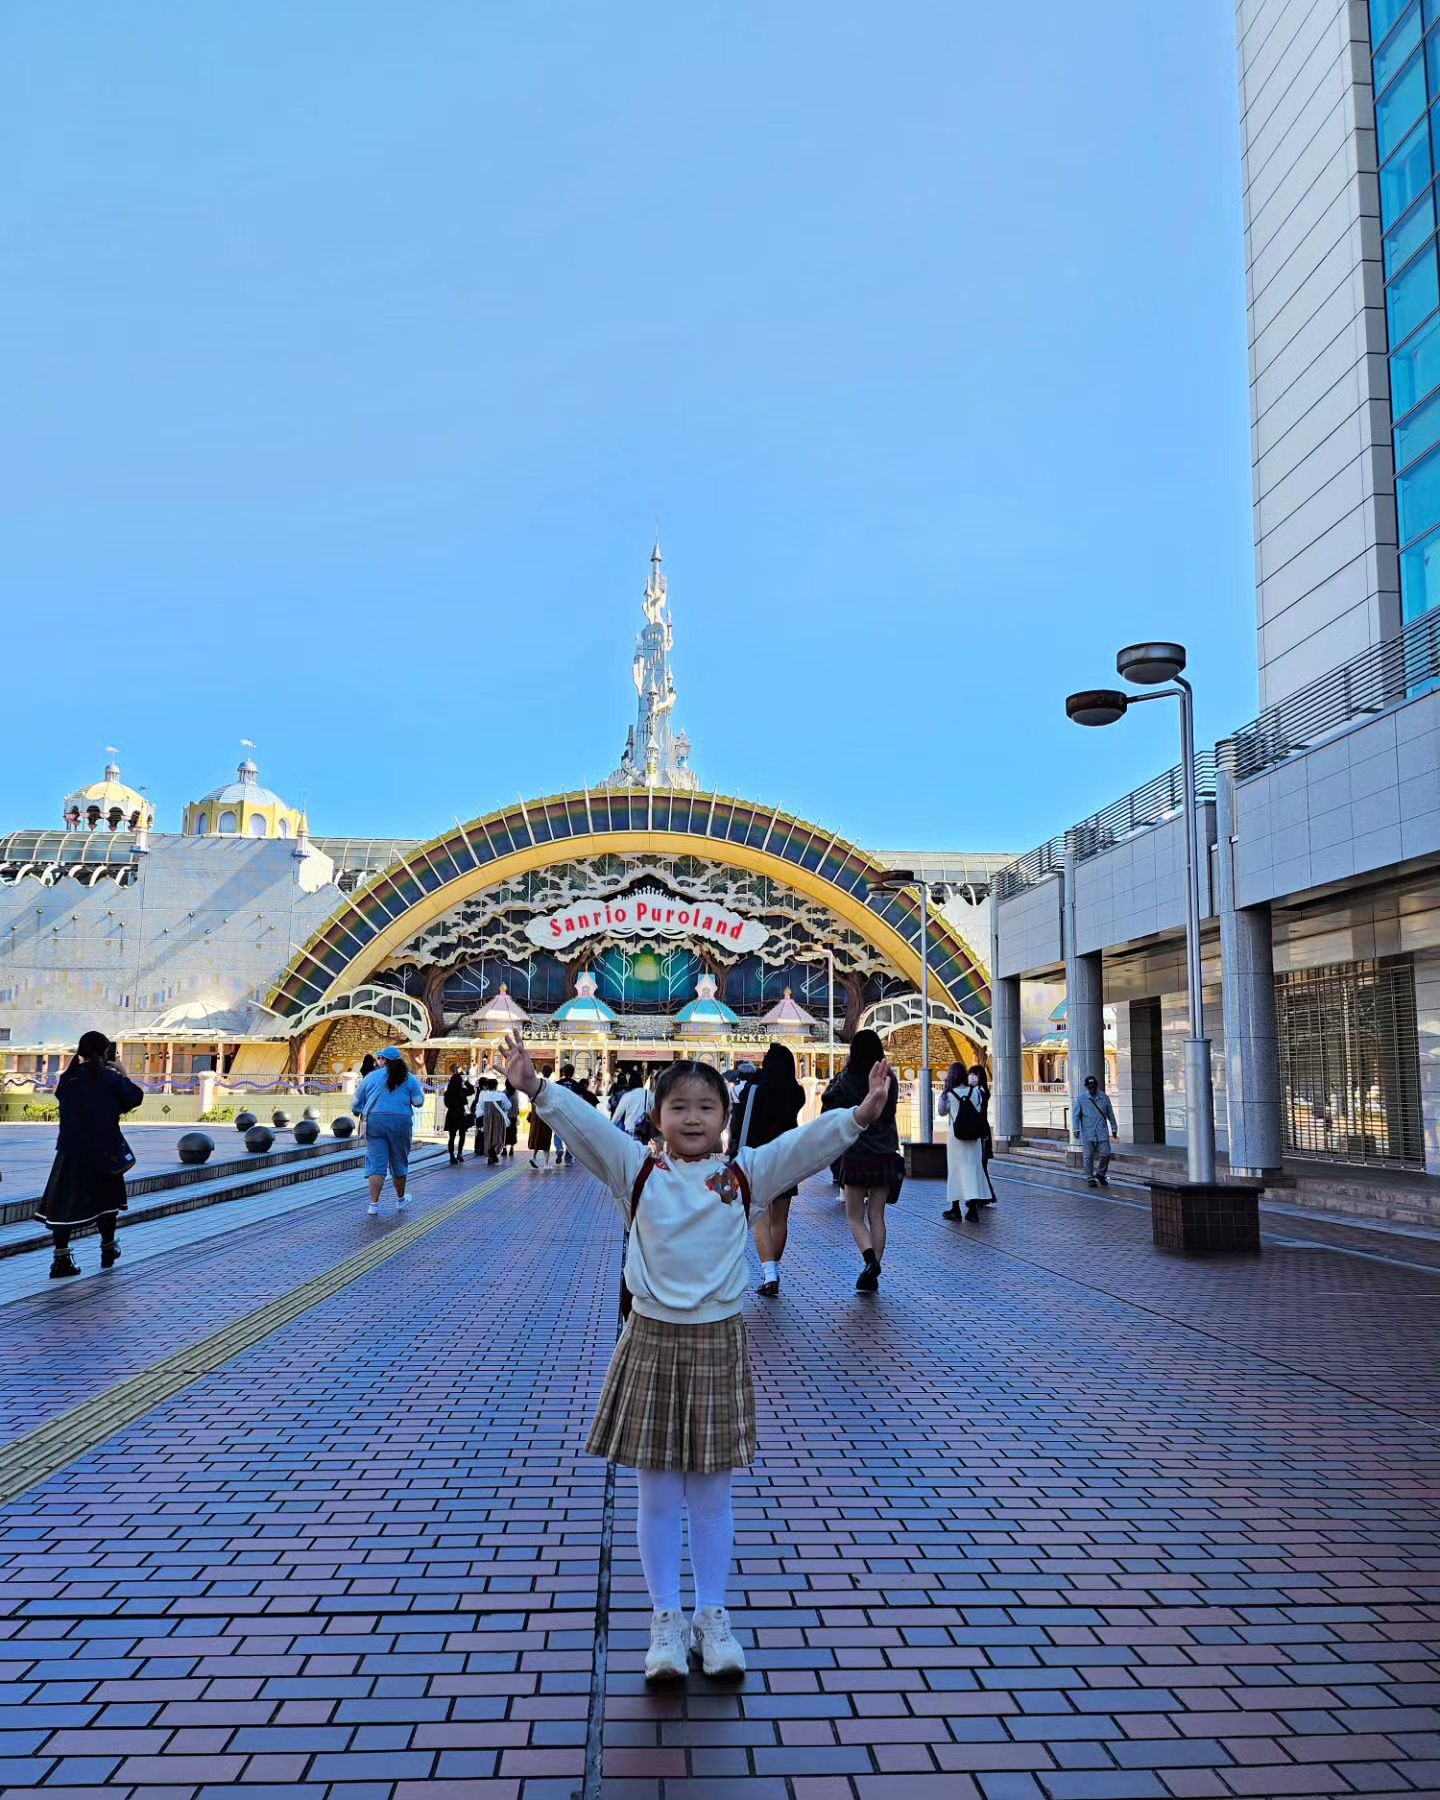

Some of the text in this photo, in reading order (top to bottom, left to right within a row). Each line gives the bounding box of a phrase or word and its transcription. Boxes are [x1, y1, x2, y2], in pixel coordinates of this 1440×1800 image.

[550, 903, 744, 940] Sanrio Puroland
[729, 1033, 778, 1042] TICKETS
